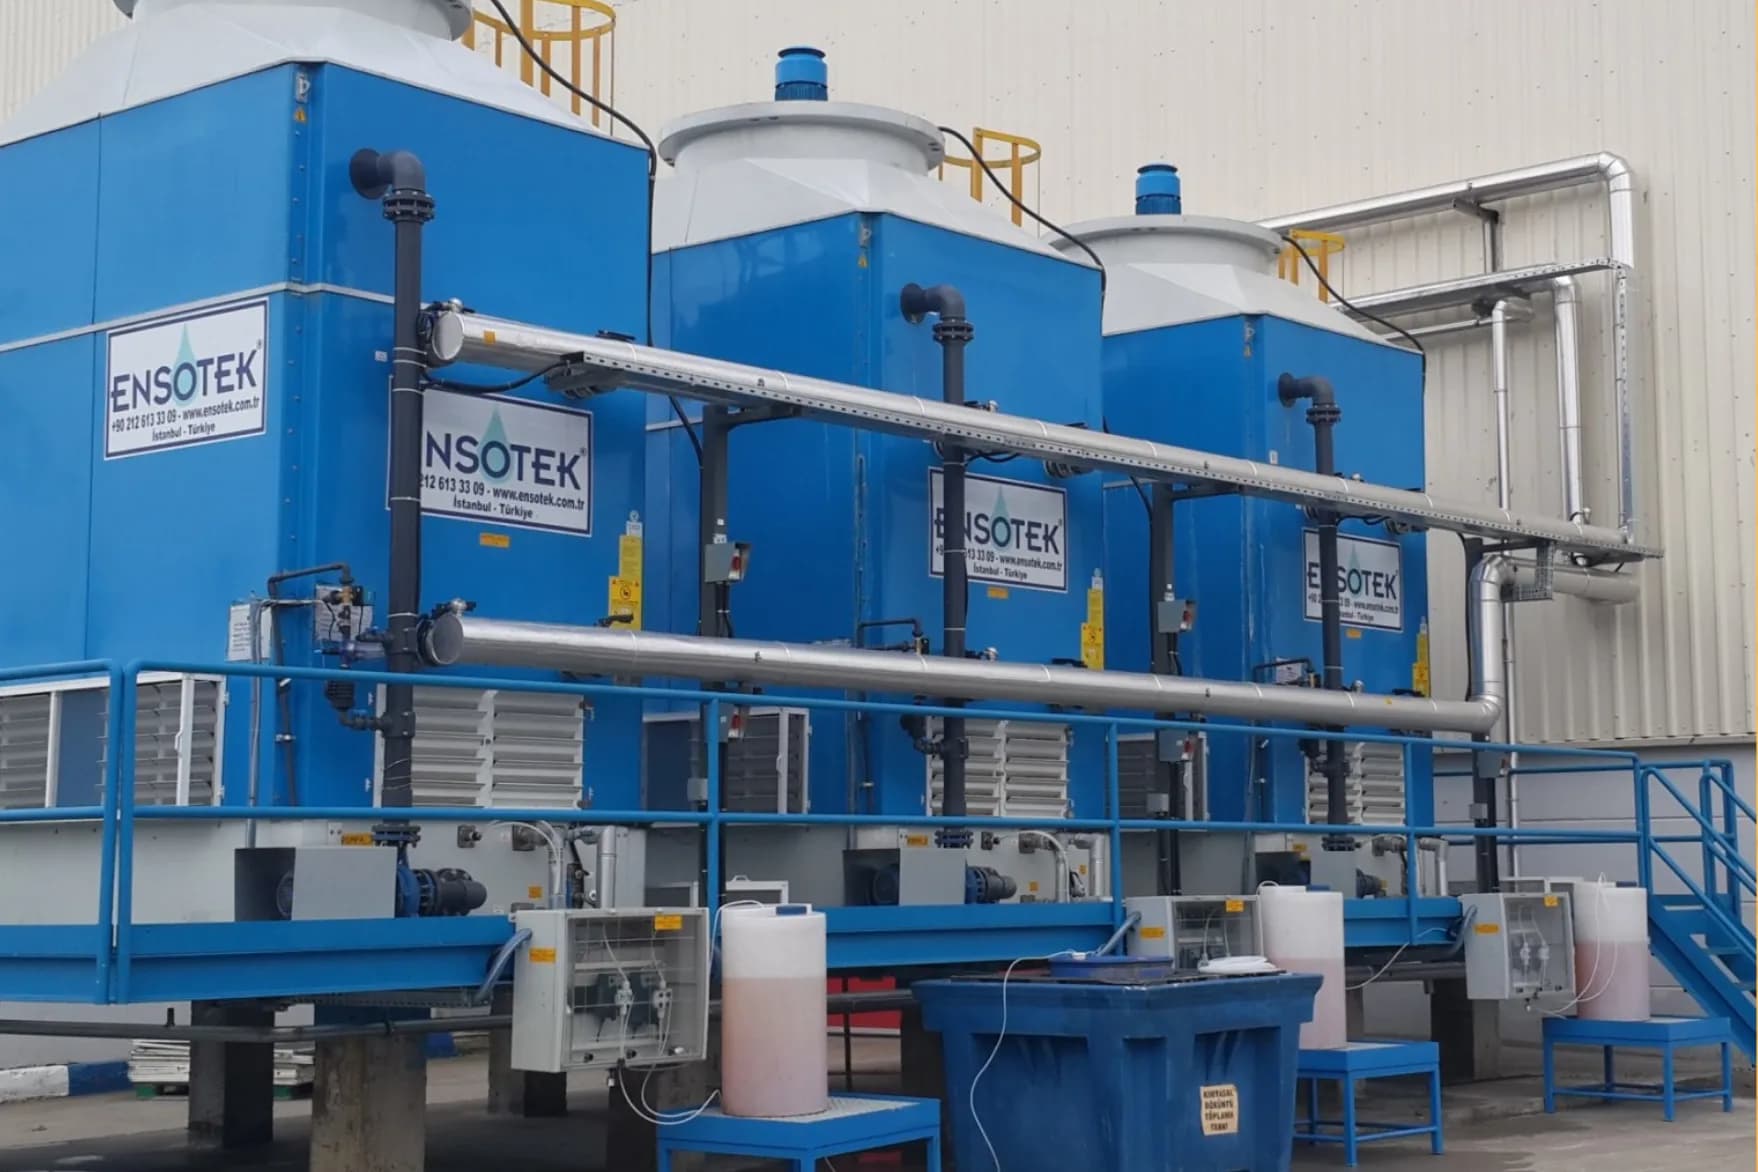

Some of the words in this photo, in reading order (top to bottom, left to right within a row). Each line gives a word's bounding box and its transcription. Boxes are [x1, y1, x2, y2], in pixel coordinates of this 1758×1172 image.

[111, 349, 256, 412] ENSOTEK
[112, 418, 124, 432] +90
[126, 415, 140, 430] 212
[142, 412, 154, 428] 613
[156, 410, 165, 425] 33
[167, 408, 176, 423] 09
[182, 396, 260, 420] www.ensotek.com.tr
[188, 422, 216, 437] Türkiye
[426, 430, 581, 490] NSOTEK
[438, 476, 456, 492] 613
[459, 479, 470, 494] 33
[473, 481, 484, 496] 09
[492, 486, 584, 510] www.ensotek.com.tr
[500, 504, 533, 520] Türkiye
[1308, 562, 1396, 600] ESOTEK
